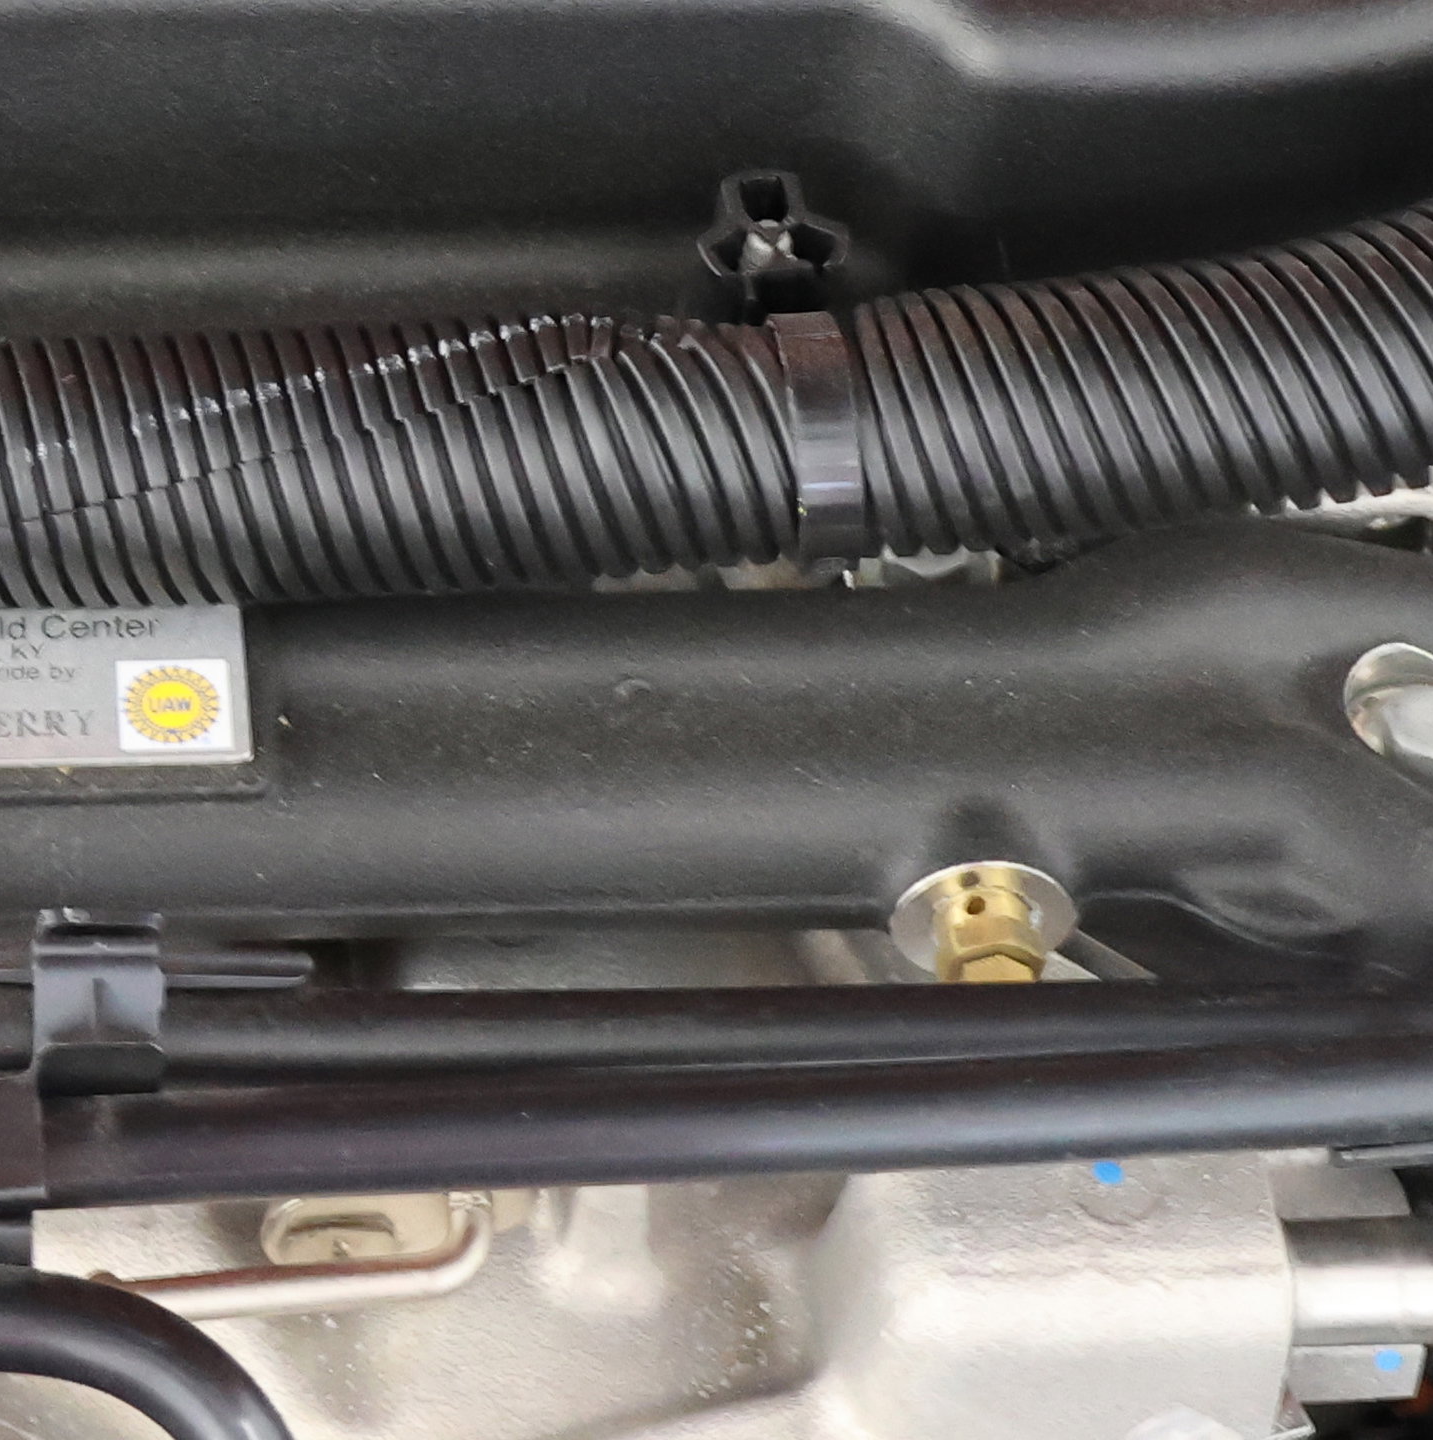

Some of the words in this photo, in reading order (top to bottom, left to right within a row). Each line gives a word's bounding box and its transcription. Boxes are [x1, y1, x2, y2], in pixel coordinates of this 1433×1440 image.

[41, 614, 160, 639] Center
[11, 642, 44, 659] KY
[49, 661, 76, 683] by
[149, 695, 193, 714] UAW
